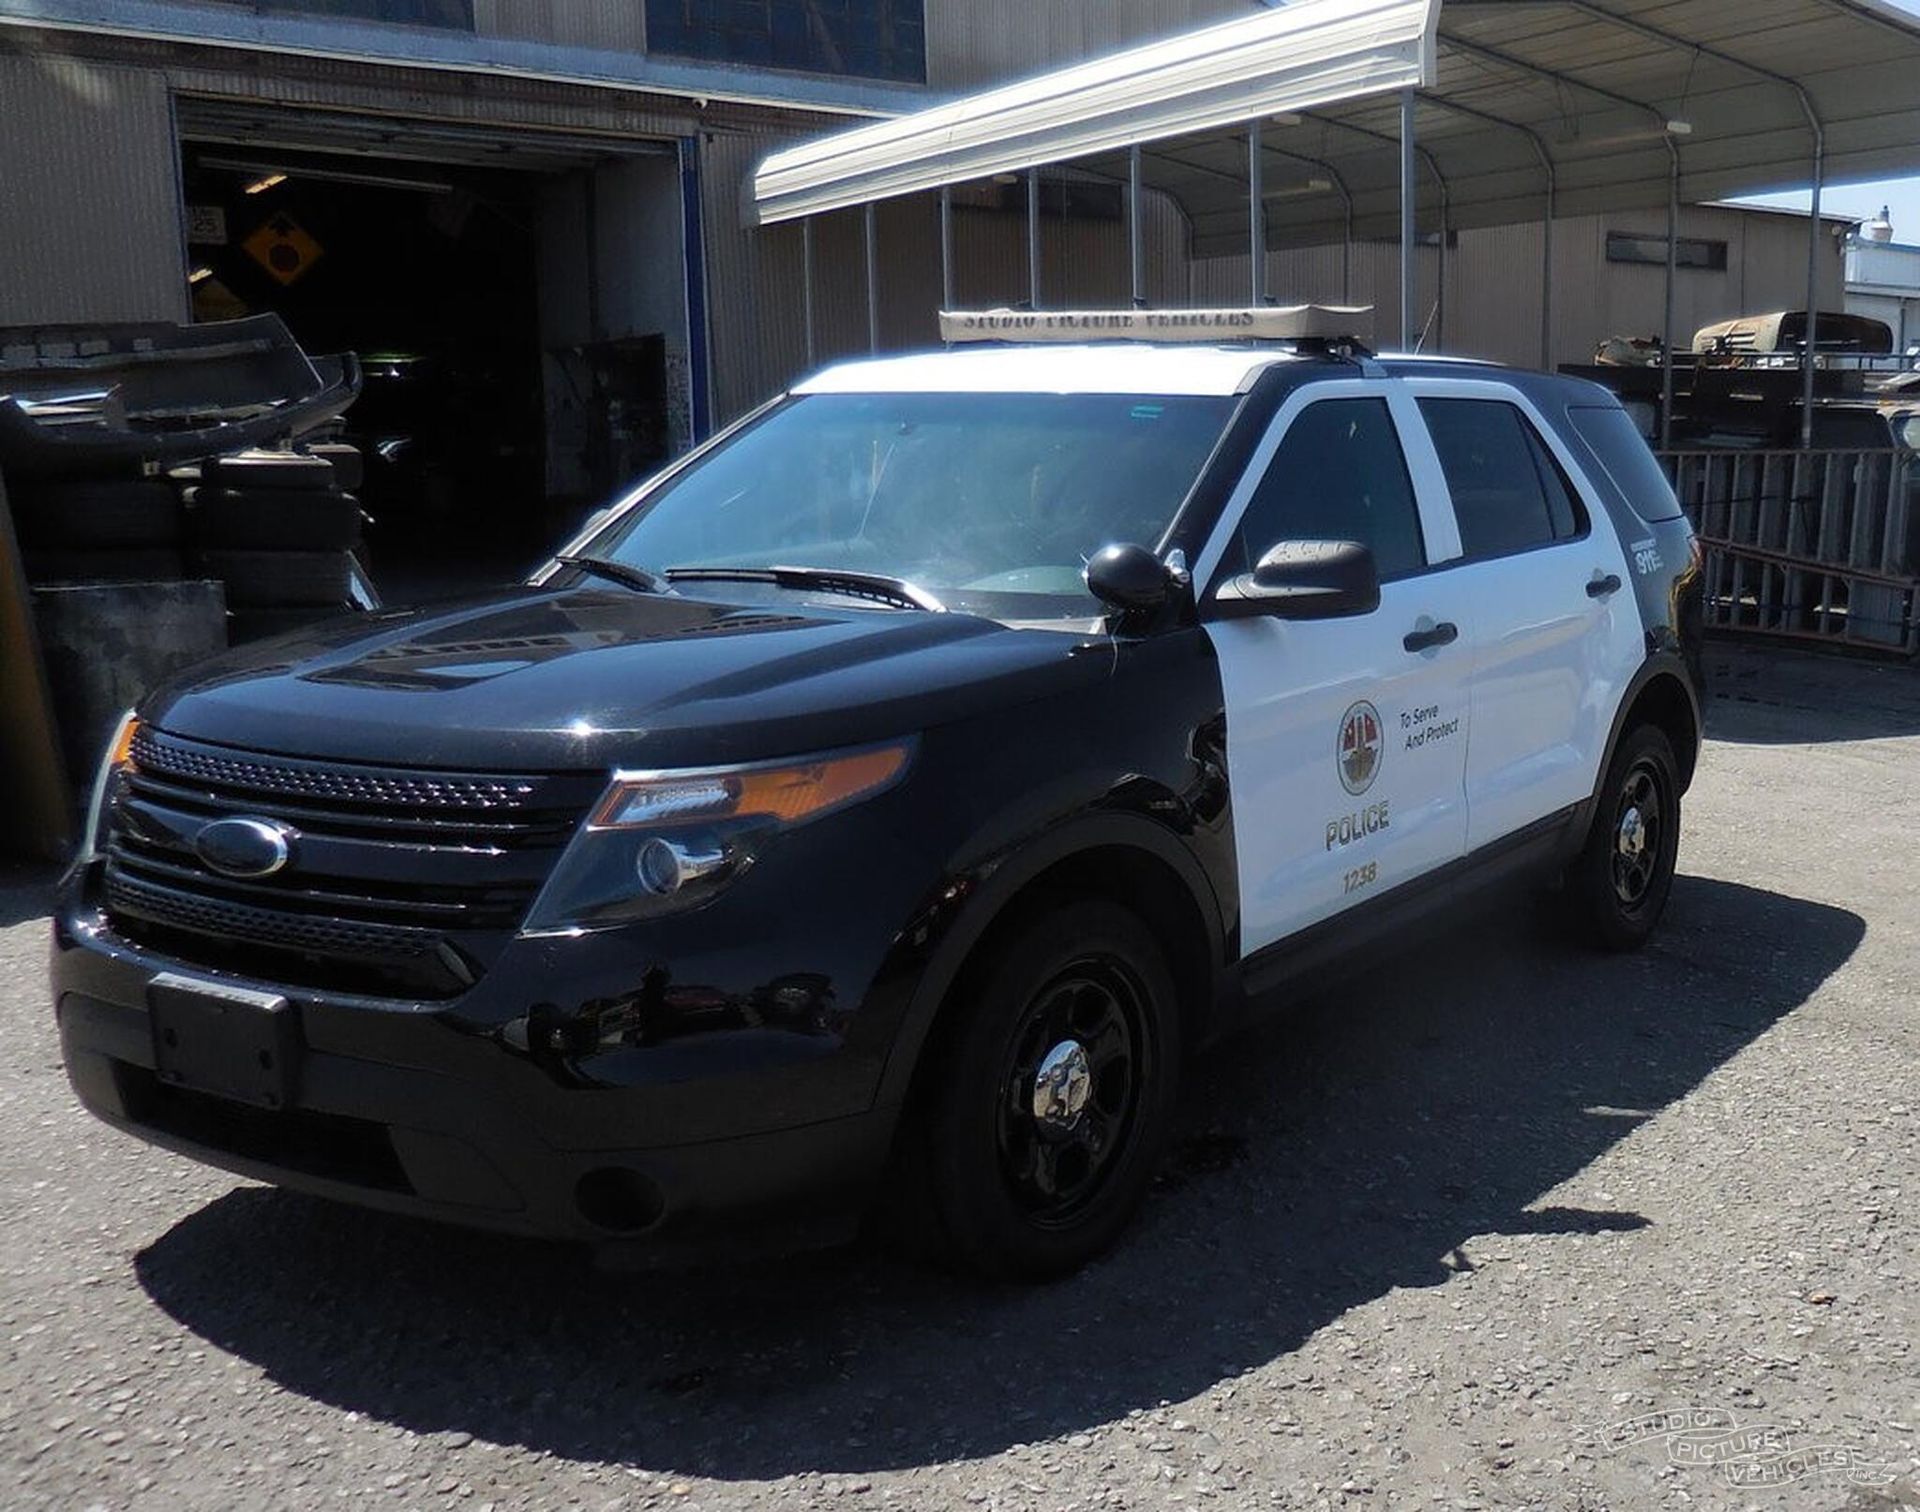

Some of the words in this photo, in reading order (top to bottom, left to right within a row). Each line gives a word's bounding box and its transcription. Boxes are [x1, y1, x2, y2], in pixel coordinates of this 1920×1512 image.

[1400, 711, 1412, 730] To
[1413, 704, 1439, 725] Serve
[1405, 727, 1425, 751] And
[1425, 717, 1459, 744] Protect
[1325, 800, 1390, 852] POLICE
[1343, 861, 1378, 895] 1238
